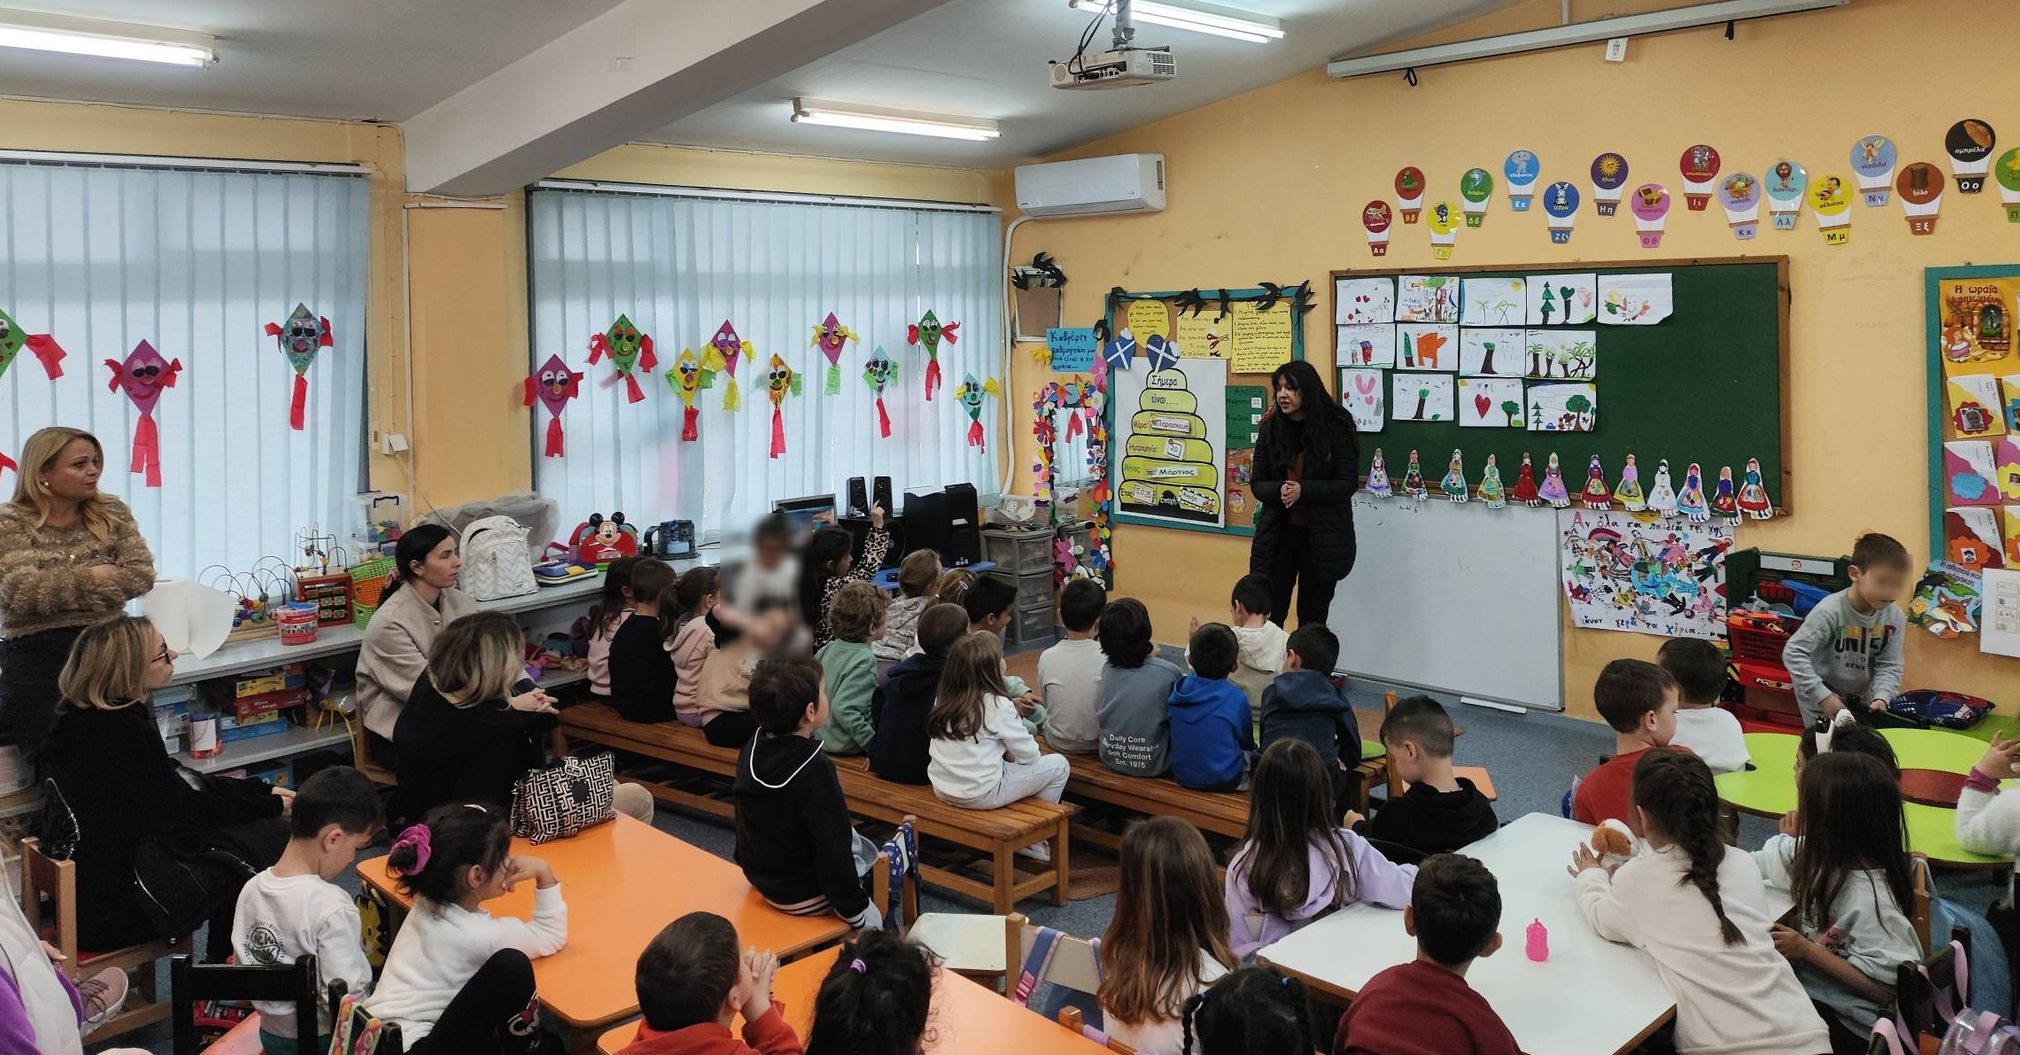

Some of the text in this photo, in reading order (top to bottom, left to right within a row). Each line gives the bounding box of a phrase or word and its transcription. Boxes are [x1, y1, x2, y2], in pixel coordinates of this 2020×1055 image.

[1968, 284, 1999, 295] ωραία
[1151, 375, 1178, 387] Σήμερα
[1159, 468, 1195, 477] Μάρτιος
[1109, 733, 1146, 744] Daily Core
[1121, 752, 1152, 761] Comfort
